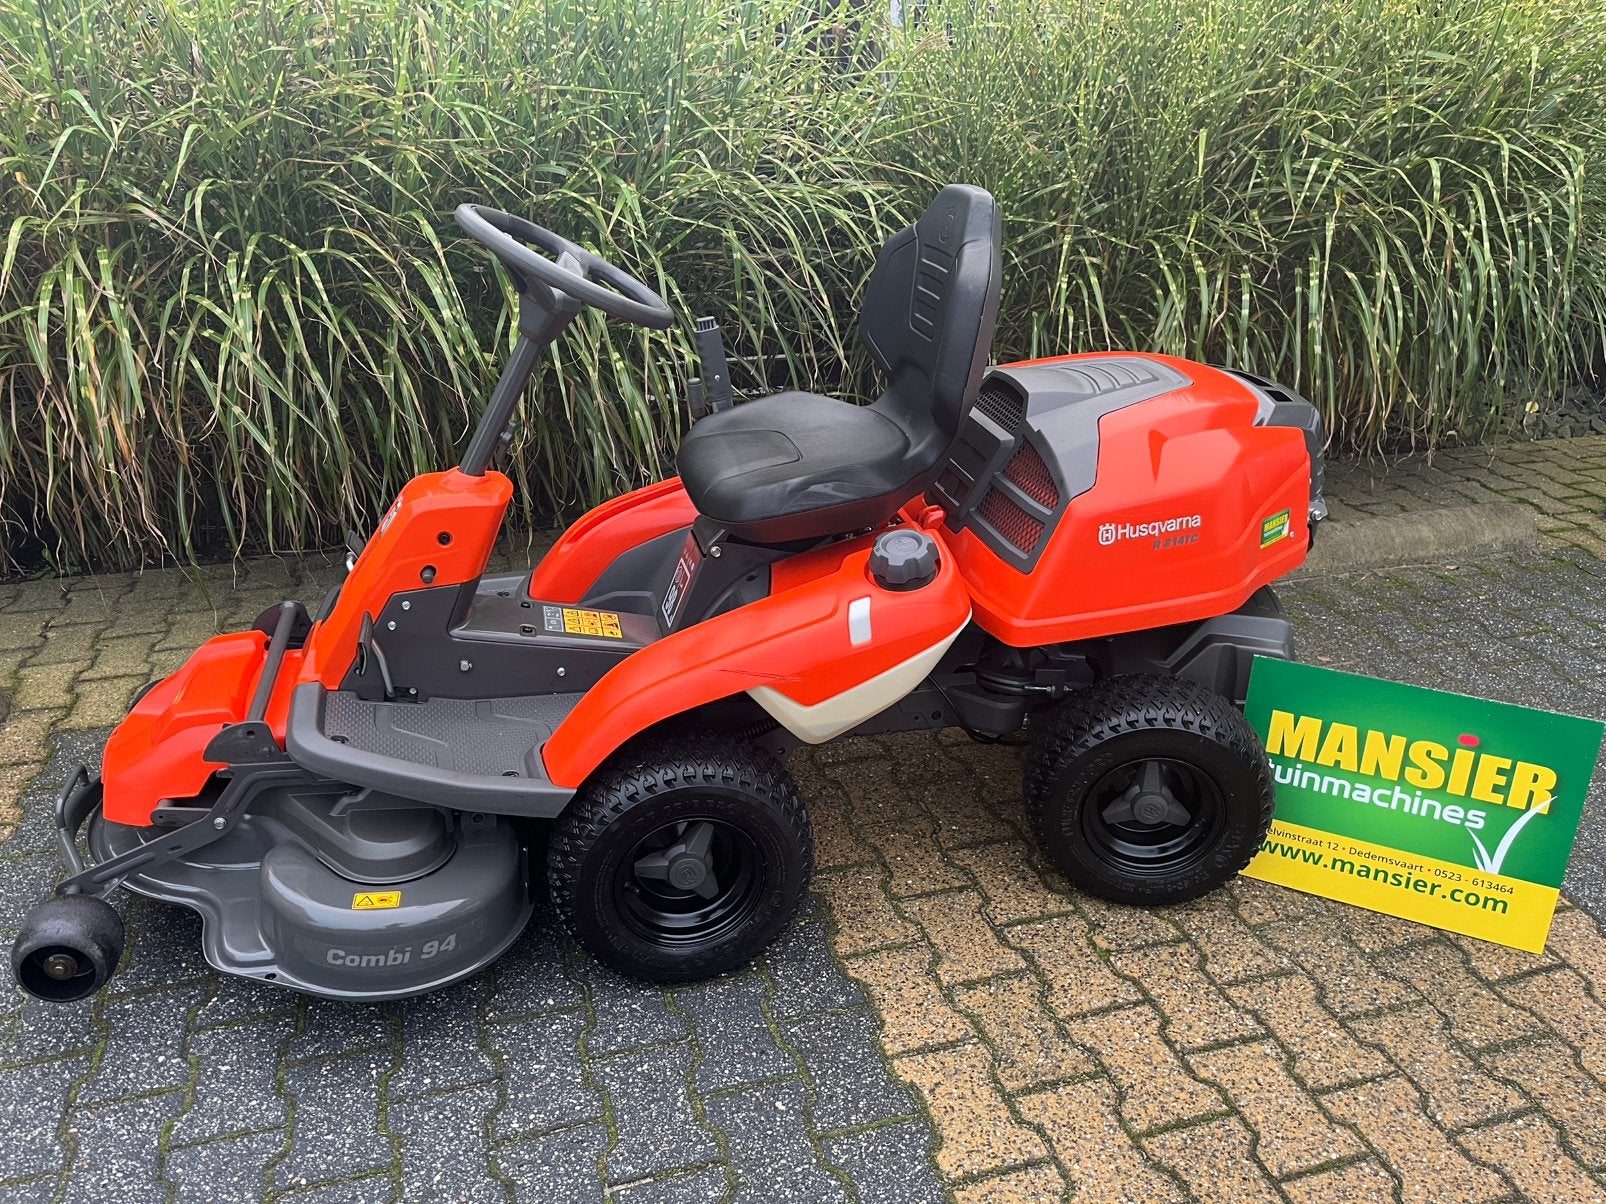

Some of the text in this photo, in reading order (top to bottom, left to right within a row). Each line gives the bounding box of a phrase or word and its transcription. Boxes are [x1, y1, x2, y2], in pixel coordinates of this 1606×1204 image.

[1117, 515, 1201, 540] Husqvarna
[1152, 540, 1161, 549] R
[1260, 840, 1508, 914] www.mansier.com
[1267, 827, 1323, 847] elvinstraat
[1327, 841, 1339, 851] 12
[1349, 847, 1424, 872] Dedemsvaart
[1434, 868, 1462, 882] 0523
[1472, 878, 1514, 895] 613464
[326, 933, 457, 967] Combi 94
